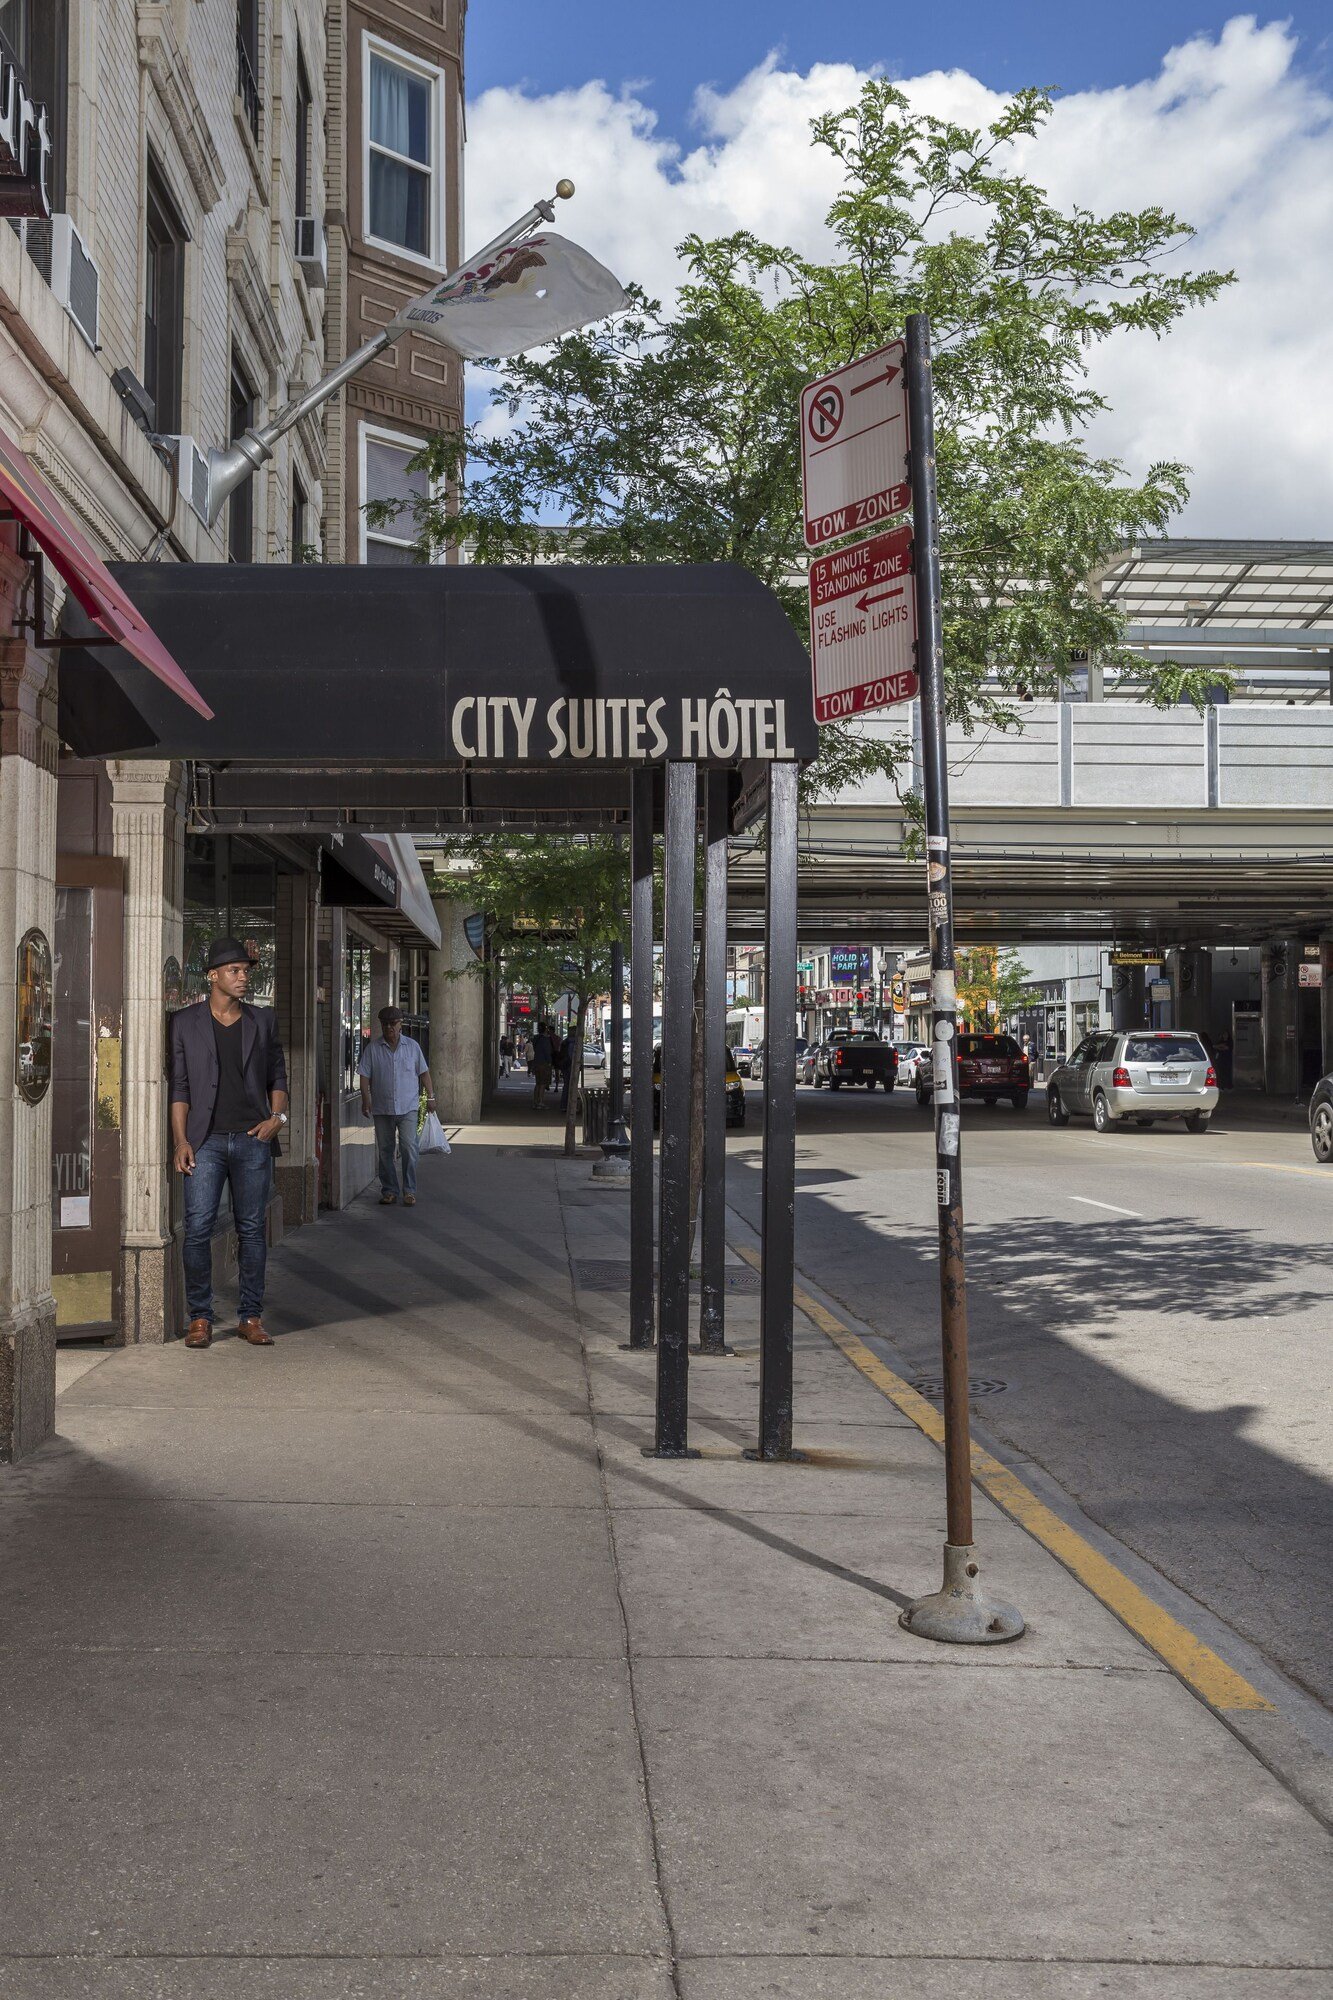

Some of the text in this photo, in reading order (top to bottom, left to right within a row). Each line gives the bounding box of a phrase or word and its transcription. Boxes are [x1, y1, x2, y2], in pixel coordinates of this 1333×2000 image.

[811, 488, 902, 541] TOW ZONE
[815, 547, 871, 582] 15 MINUTE
[816, 554, 903, 600] STANDING ZONE
[817, 610, 837, 630] USE
[818, 605, 909, 649] FLASHING LIGHTS
[821, 675, 909, 718] TOW ZONE
[451, 687, 795, 760] CITY SUITES HÔTEL
[833, 953, 868, 962] HOLIDY
